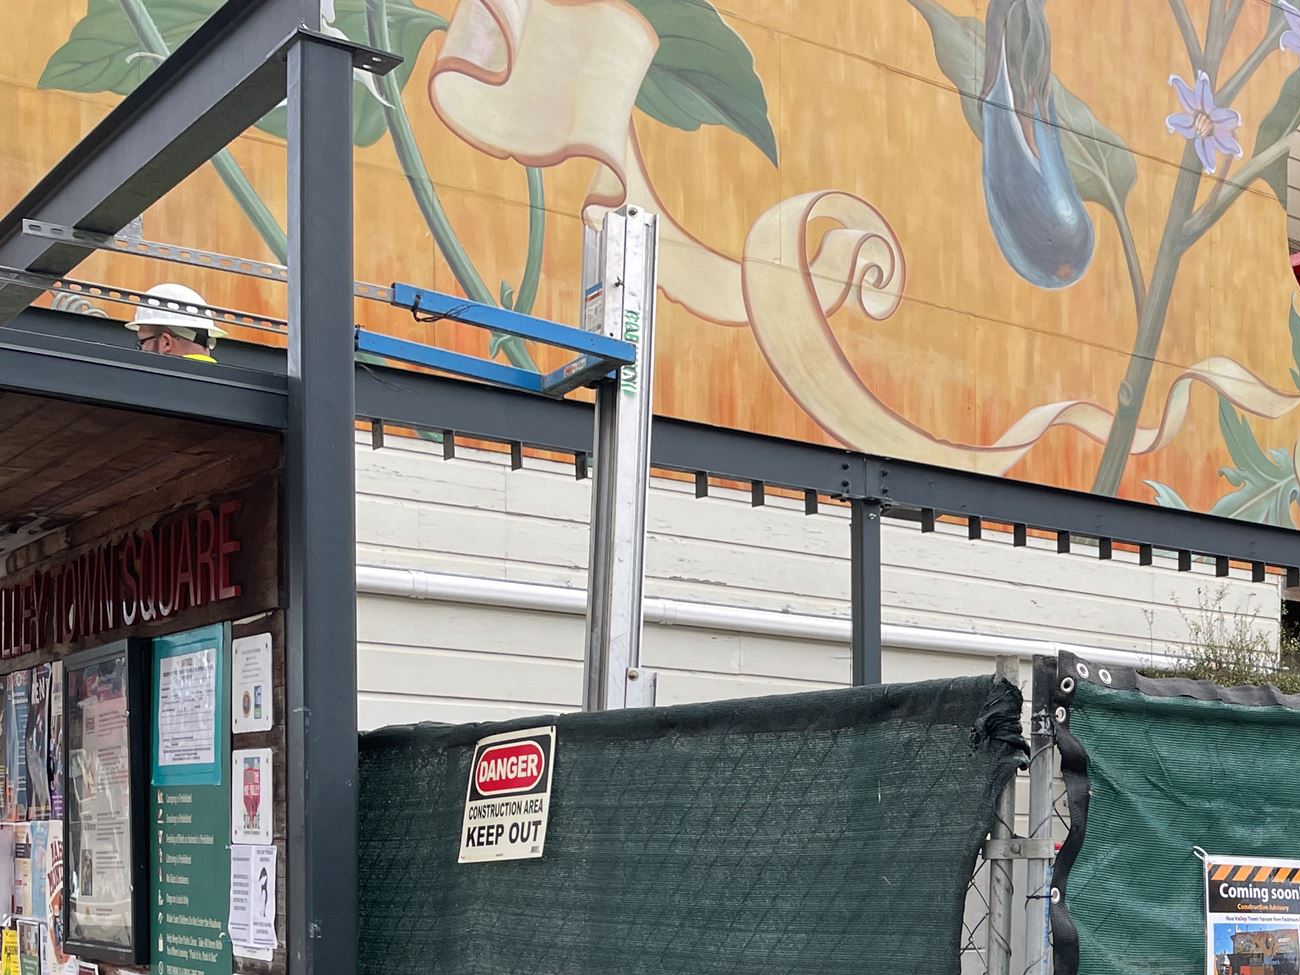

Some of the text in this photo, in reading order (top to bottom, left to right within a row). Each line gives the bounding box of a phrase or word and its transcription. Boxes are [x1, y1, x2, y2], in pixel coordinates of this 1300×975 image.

[50, 545, 114, 643] TOWN
[121, 500, 241, 626] SQUARE
[478, 754, 538, 783] DANGER
[468, 798, 543, 820] CONSTRUCTION AREA
[466, 820, 542, 848] KEEP OUT
[1220, 882, 1268, 902] Coming
